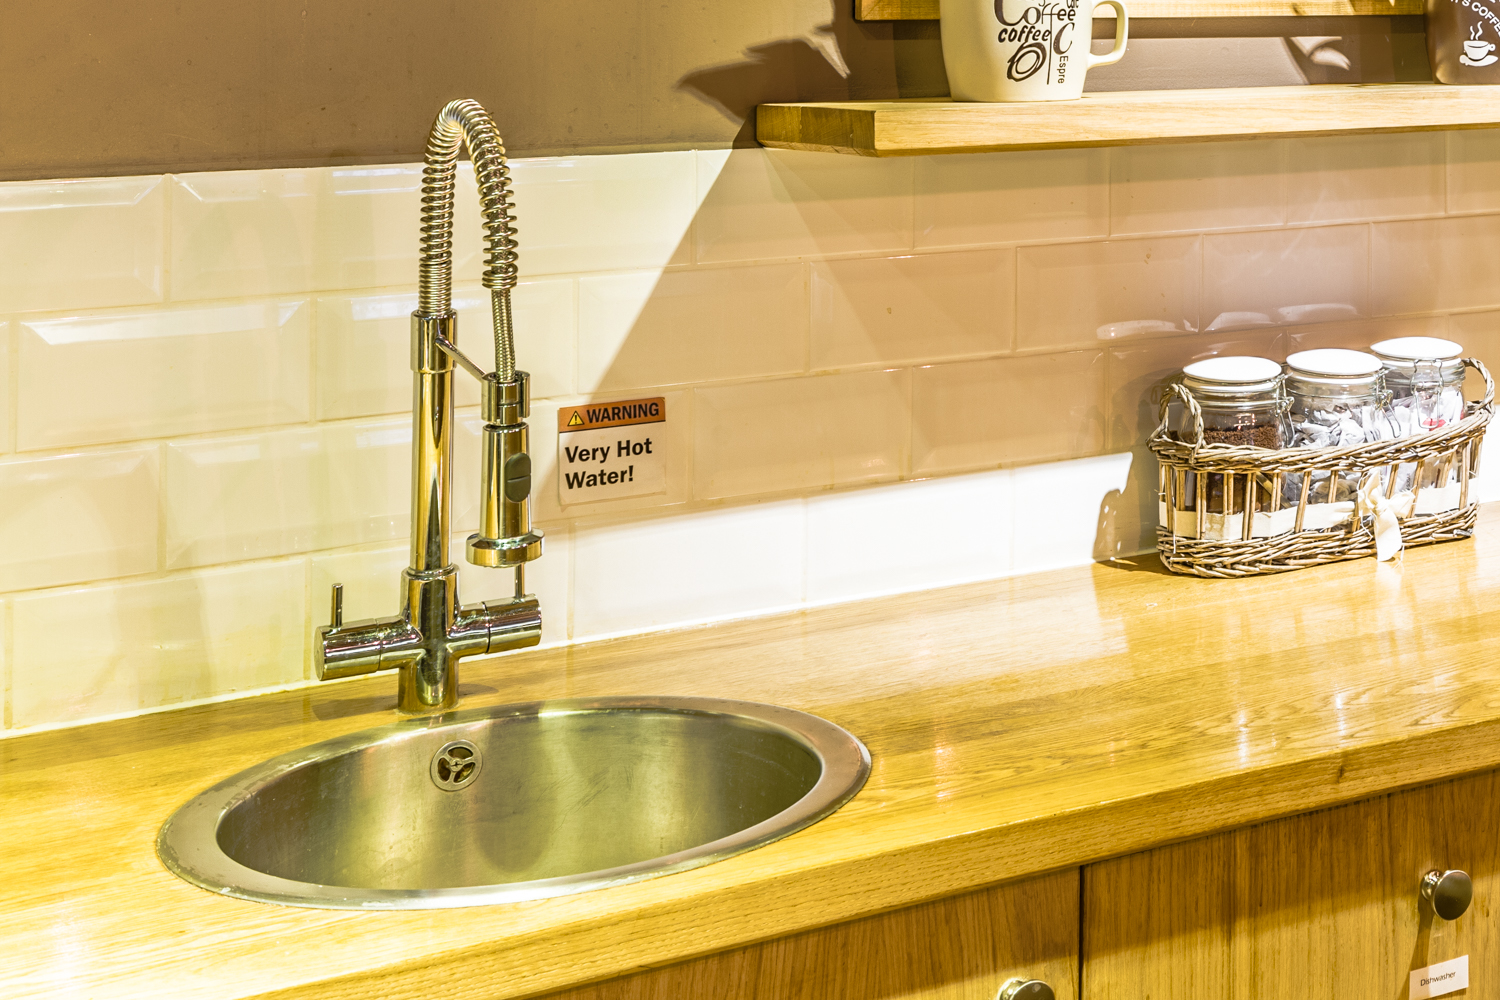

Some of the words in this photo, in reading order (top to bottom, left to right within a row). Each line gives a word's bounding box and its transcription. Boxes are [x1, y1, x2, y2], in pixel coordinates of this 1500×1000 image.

[998, 25, 1051, 43] coffee
[1057, 55, 1069, 84] Espre
[587, 402, 659, 424] WARNING
[565, 445, 610, 464] Very
[617, 438, 653, 458] Hot
[565, 465, 634, 490] Water!
[1420, 971, 1456, 987] Dishwasher
